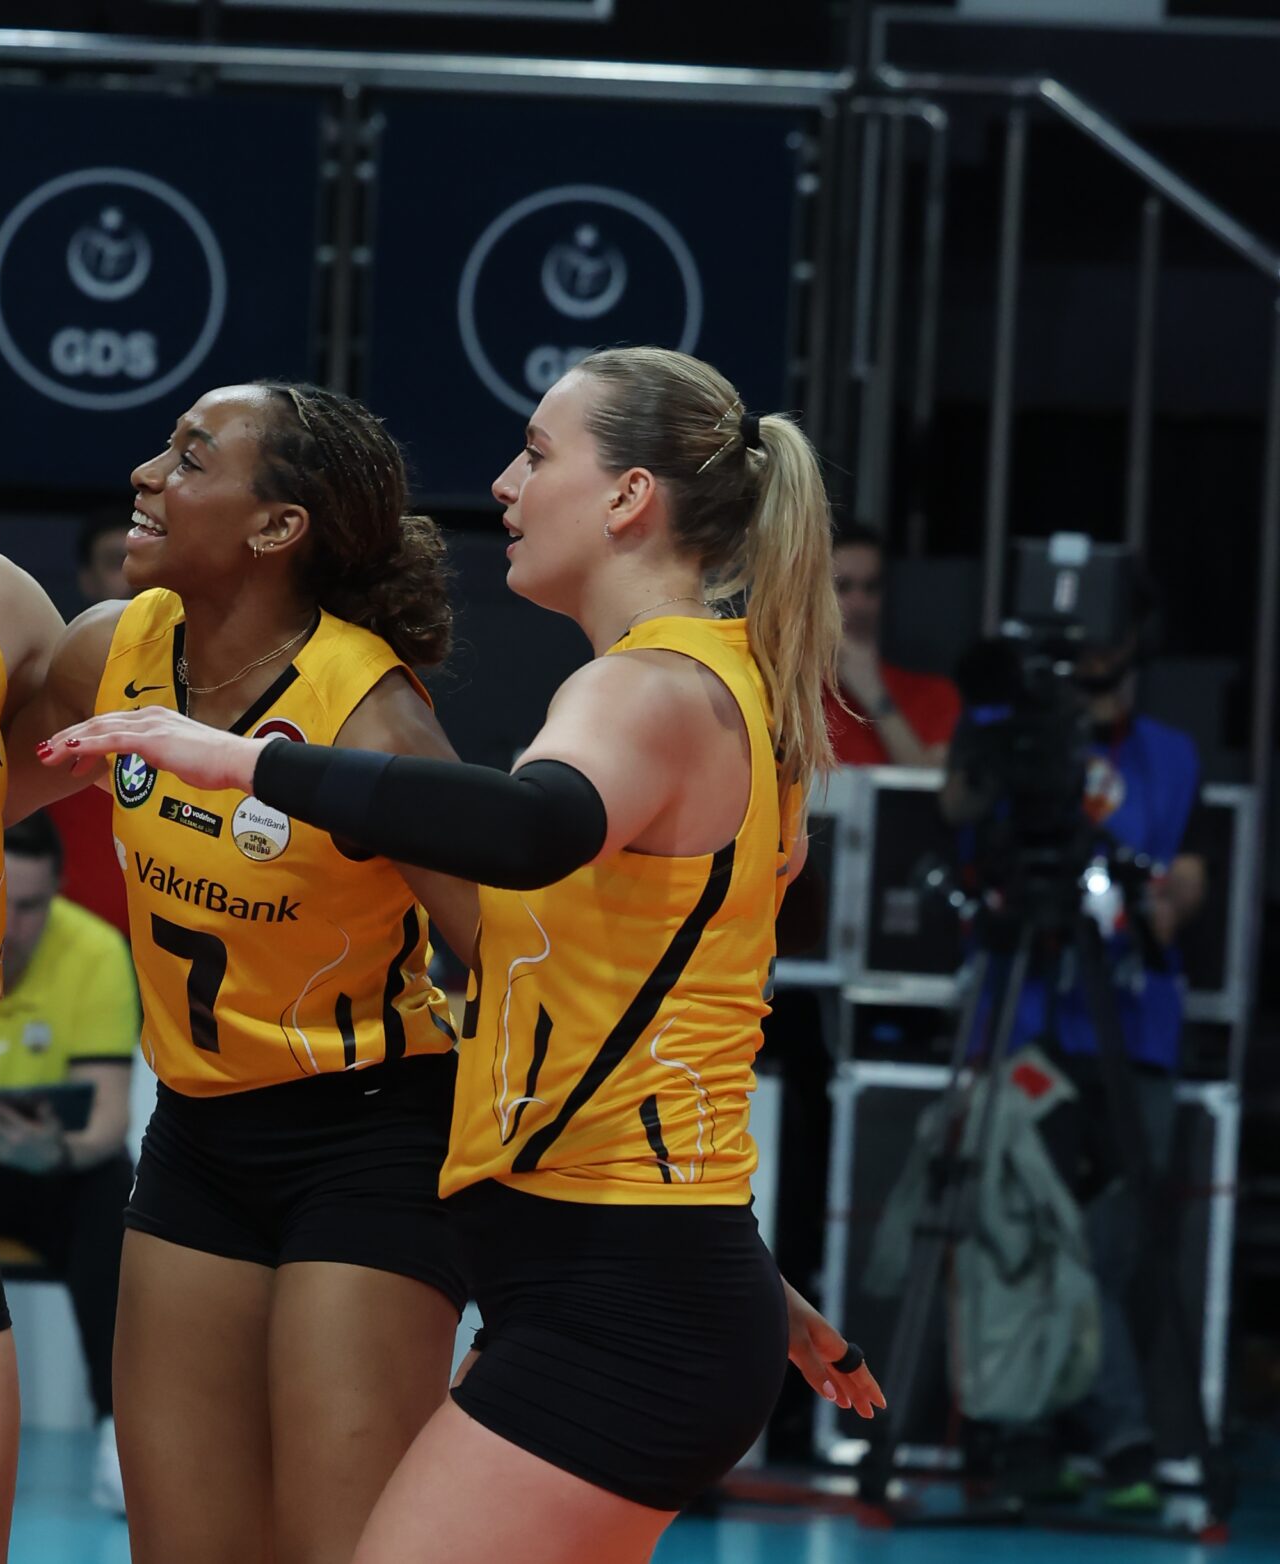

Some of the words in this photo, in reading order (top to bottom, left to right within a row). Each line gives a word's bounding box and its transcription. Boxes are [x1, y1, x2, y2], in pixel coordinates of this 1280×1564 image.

[49, 326, 157, 379] GDS
[192, 811, 217, 825] vodafone
[250, 834, 267, 846] SPOR
[135, 851, 301, 922] VakıfBank
[150, 912, 227, 1054] 7
